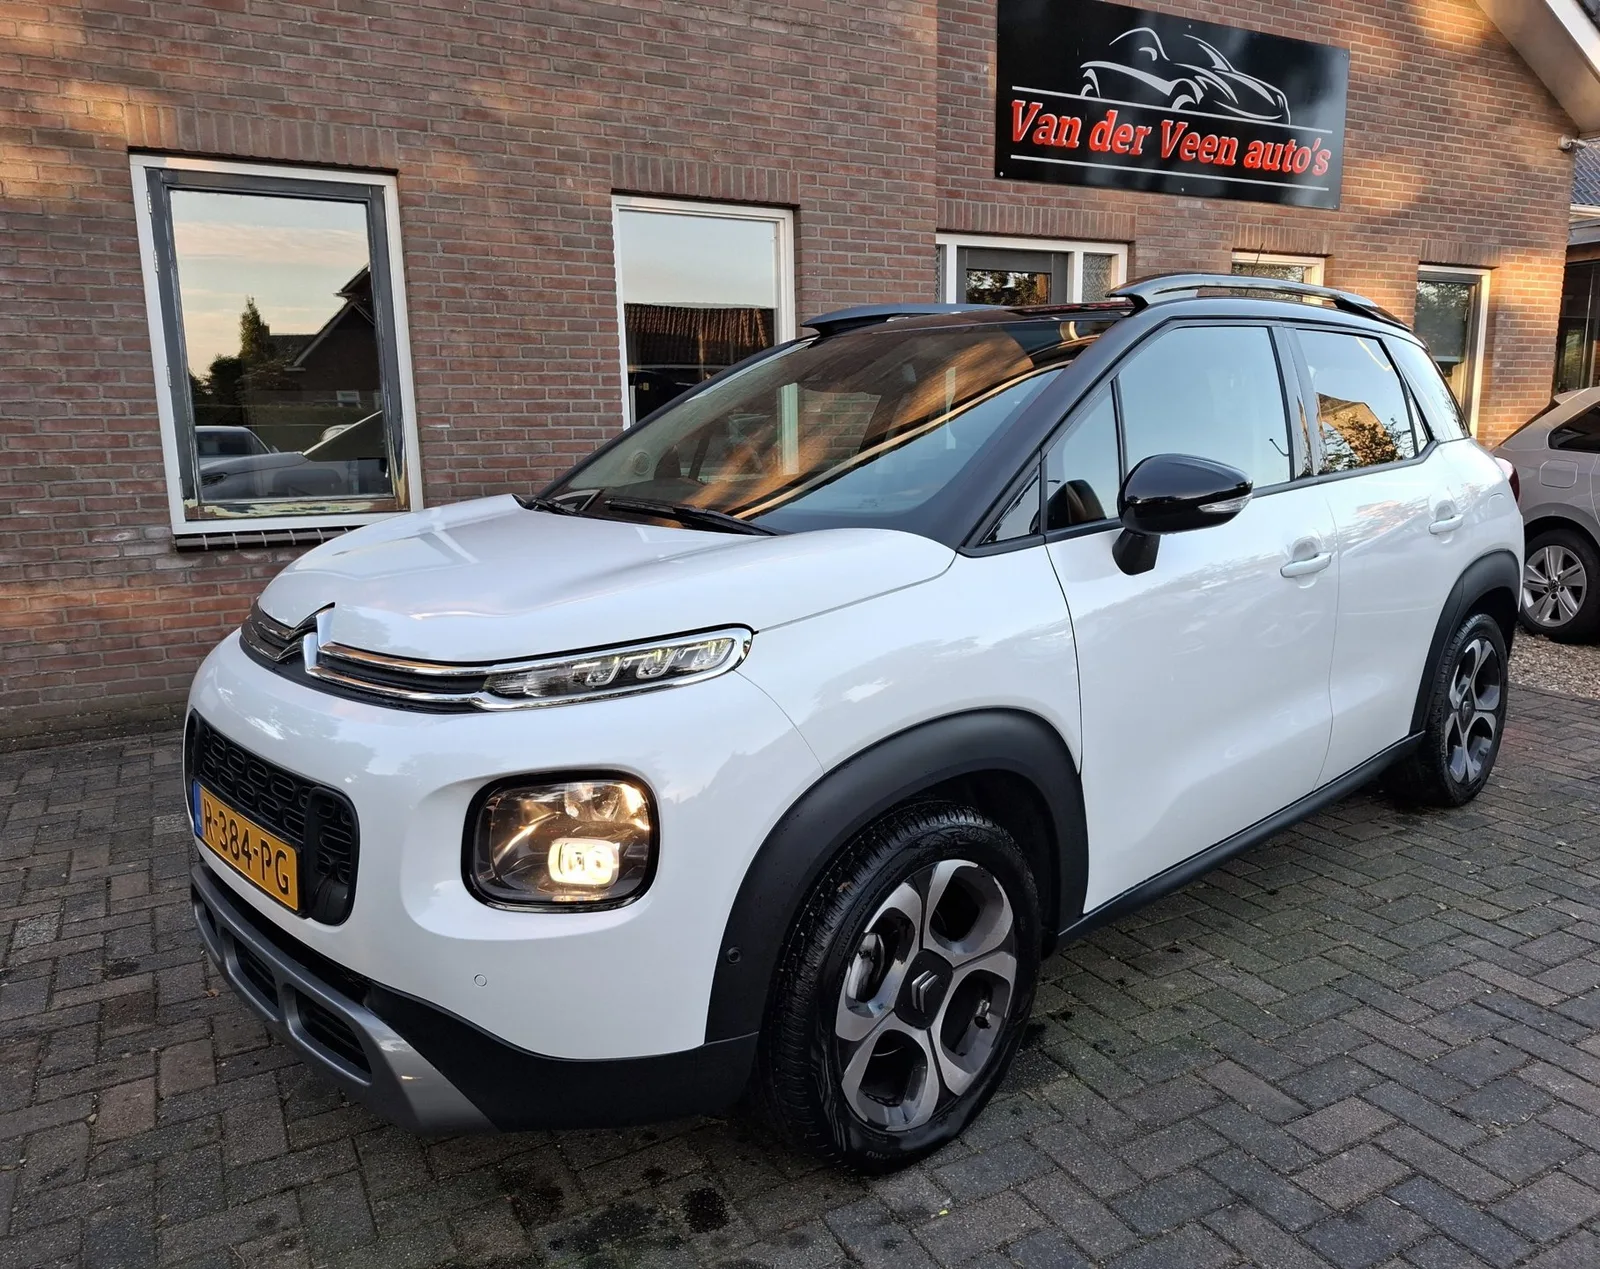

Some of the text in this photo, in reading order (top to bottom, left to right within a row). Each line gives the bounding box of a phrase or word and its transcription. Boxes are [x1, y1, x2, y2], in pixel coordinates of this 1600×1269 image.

[1011, 100, 1331, 177] Van der Veen auto's
[203, 798, 290, 896] R-384-PG
